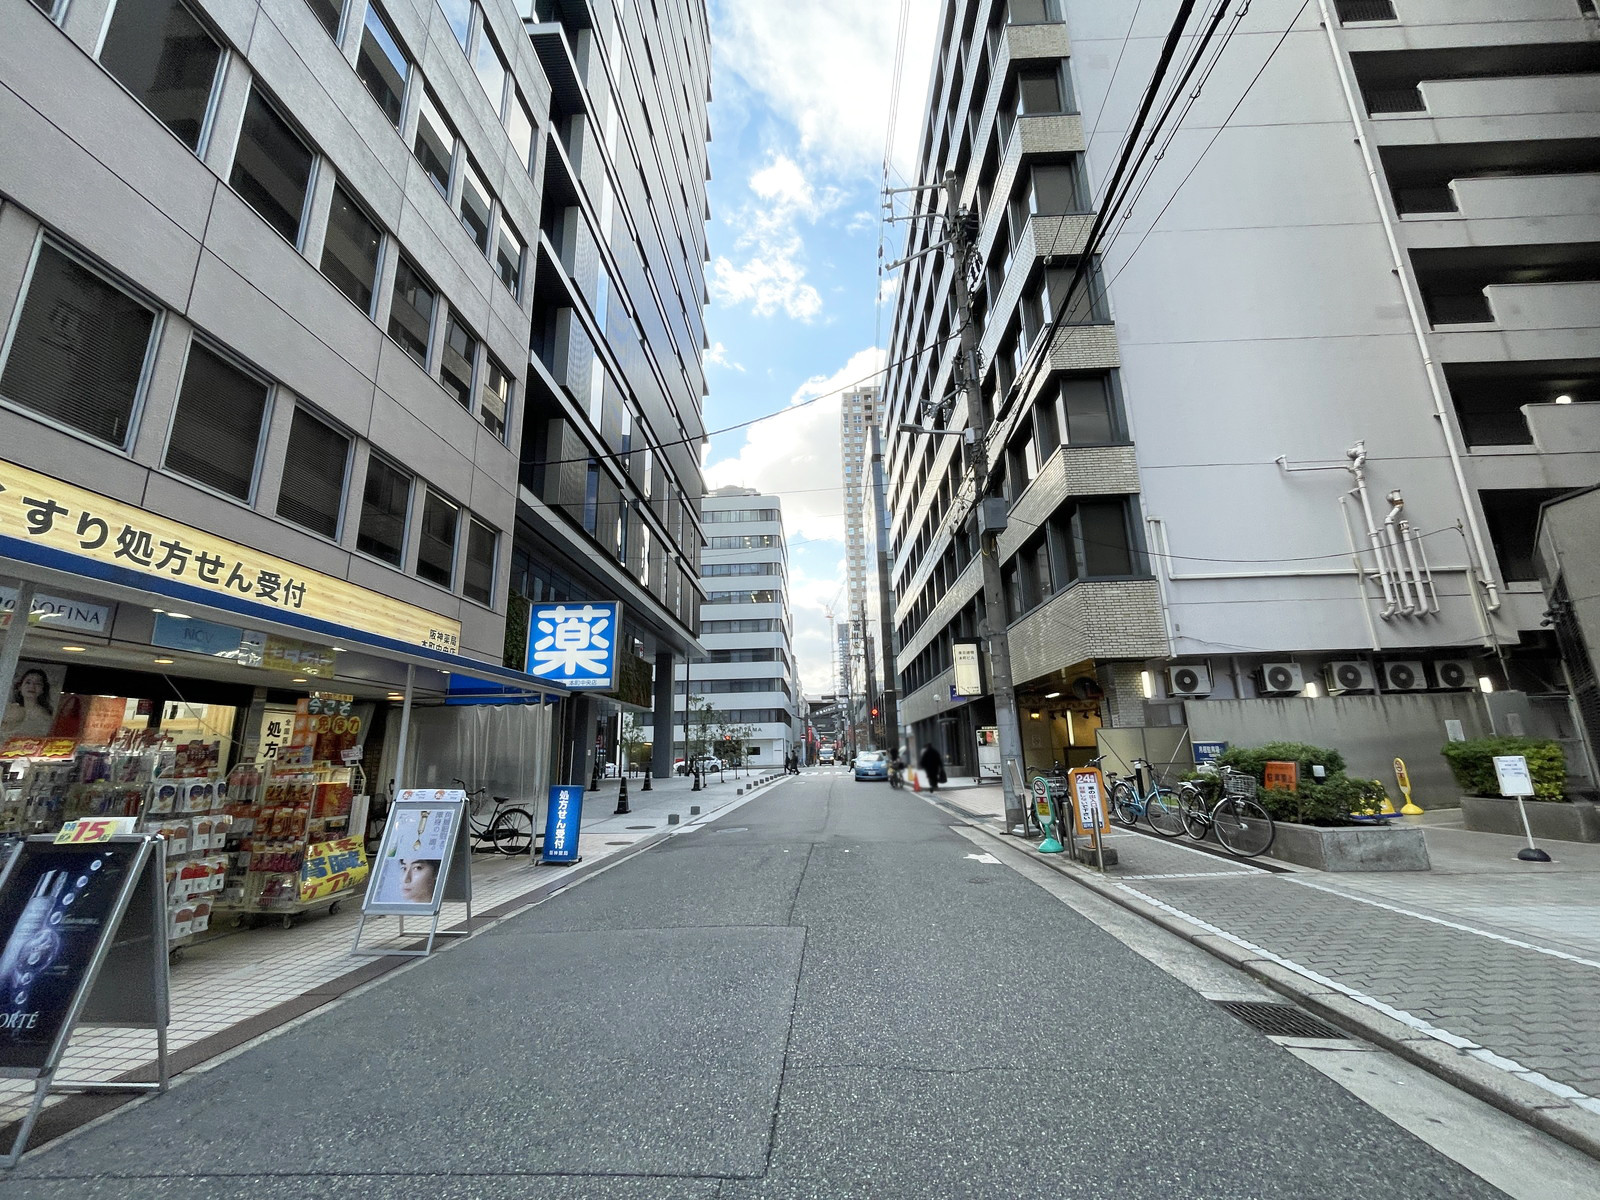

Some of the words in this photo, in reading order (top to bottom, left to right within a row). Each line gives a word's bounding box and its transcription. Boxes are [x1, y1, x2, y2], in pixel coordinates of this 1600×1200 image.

[0, 483, 307, 608] すり処方せん受付
[31, 599, 100, 624] SOFINA
[430, 629, 457, 646] 阪神薬局
[533, 605, 611, 675] 薬
[309, 700, 351, 716] 今こそ
[312, 716, 360, 733] 免疫力
[263, 720, 281, 758] 処方
[71, 821, 111, 842] 15
[554, 790, 569, 849] 処方せん受付
